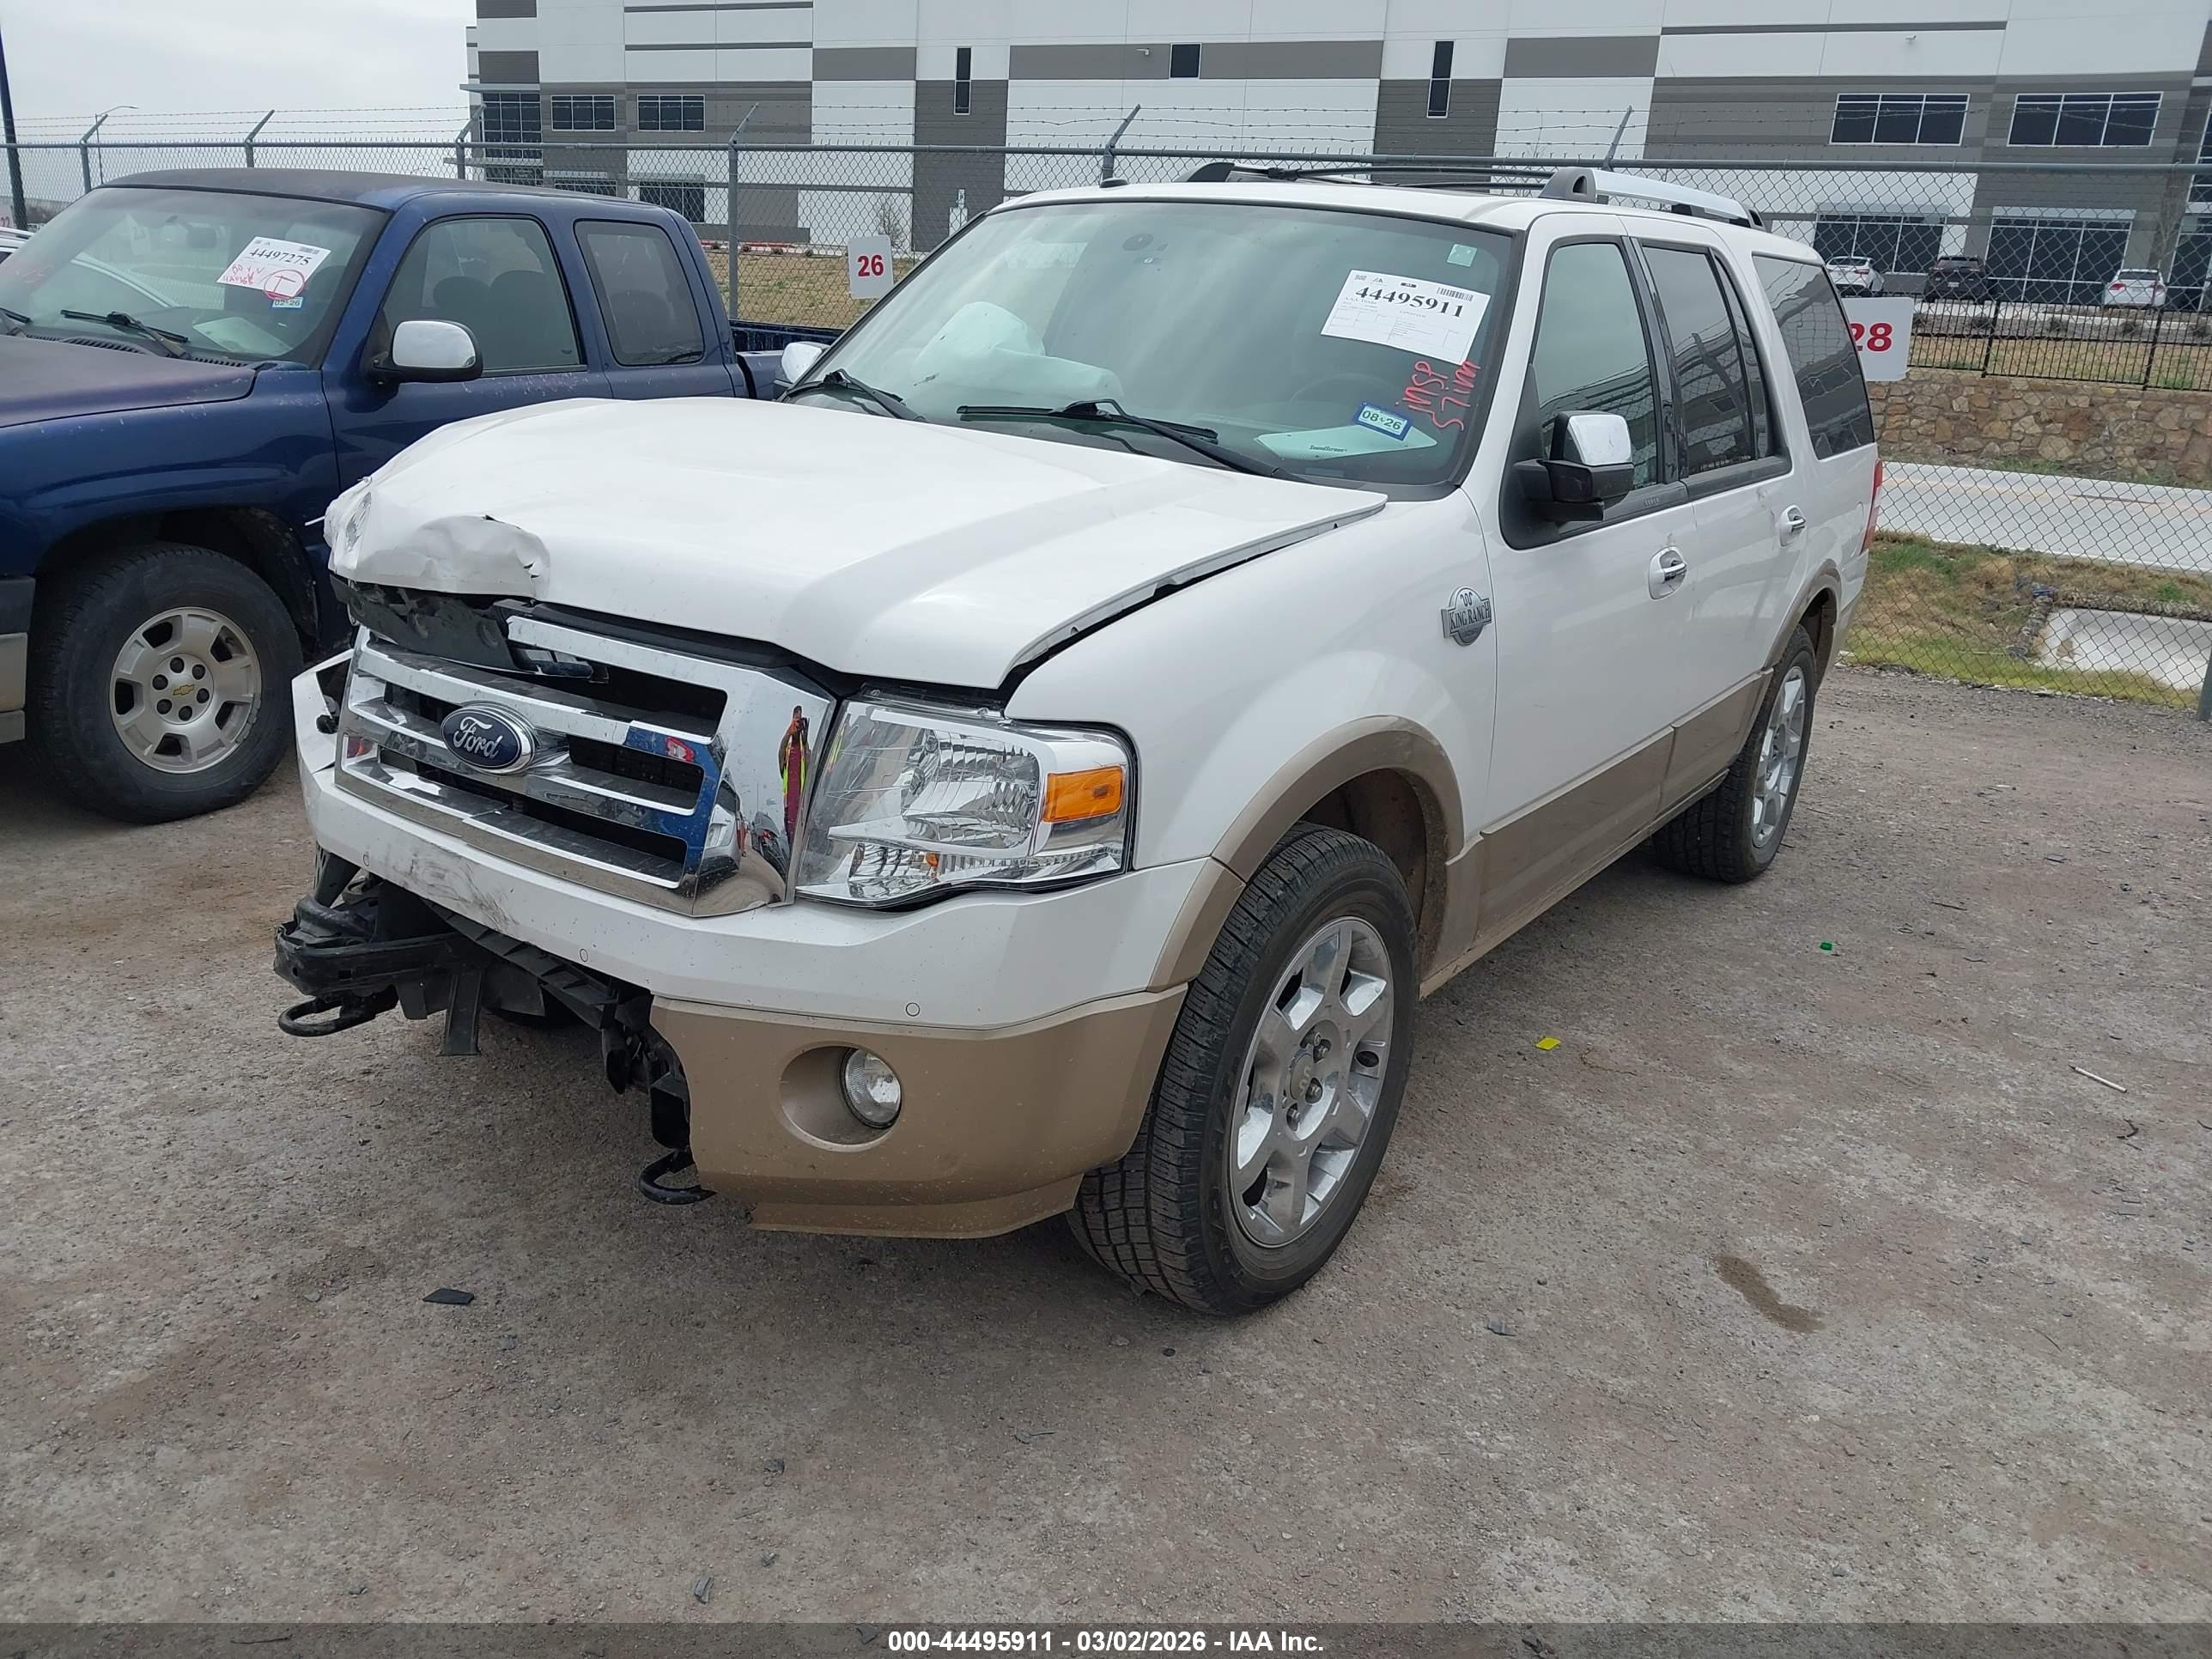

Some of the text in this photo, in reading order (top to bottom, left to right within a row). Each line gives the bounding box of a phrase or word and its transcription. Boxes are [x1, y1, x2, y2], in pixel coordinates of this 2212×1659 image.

[249, 247, 313, 266] 44497275
[857, 254, 884, 276] 26
[1355, 286, 1464, 319] 44495911
[1849, 322, 1893, 352] 28
[1449, 599, 1492, 630] KING RANCH
[453, 716, 503, 759] Ford
